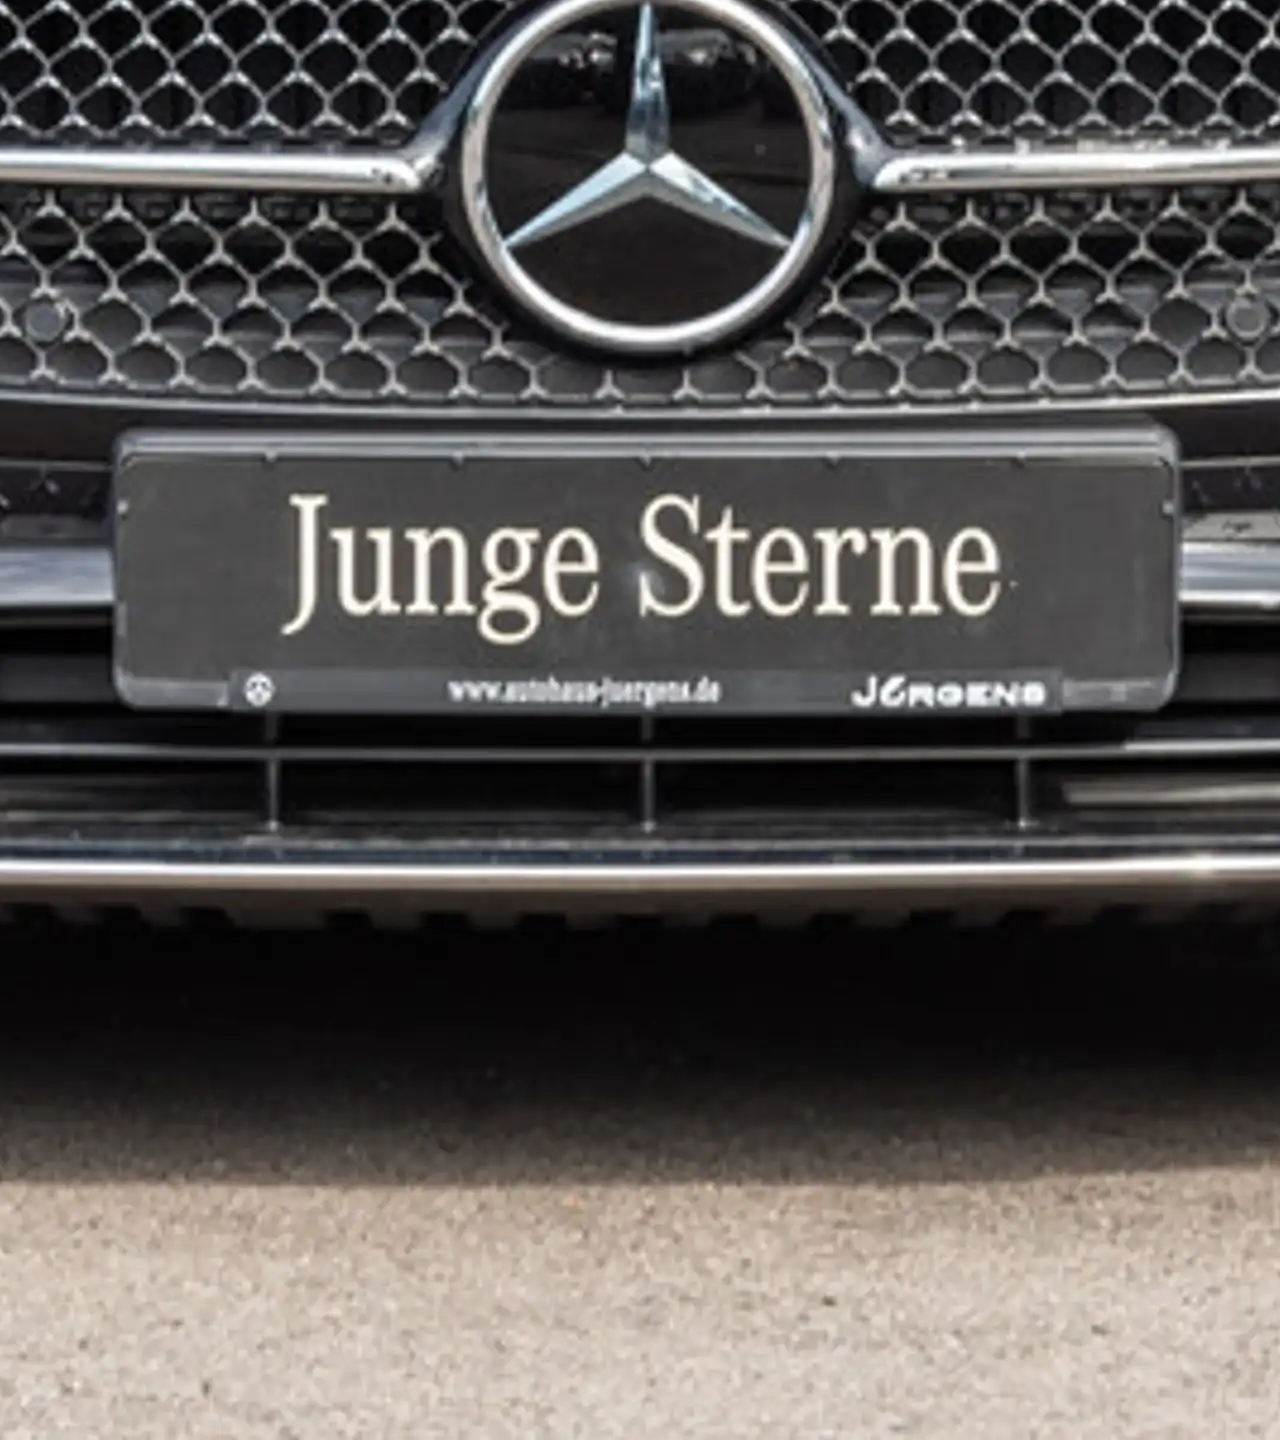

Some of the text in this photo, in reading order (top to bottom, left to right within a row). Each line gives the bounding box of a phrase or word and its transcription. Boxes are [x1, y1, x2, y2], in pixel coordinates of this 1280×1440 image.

[279, 491, 1001, 645] Junge Sterne
[446, 673, 722, 709] www.autohaus-juergens.de
